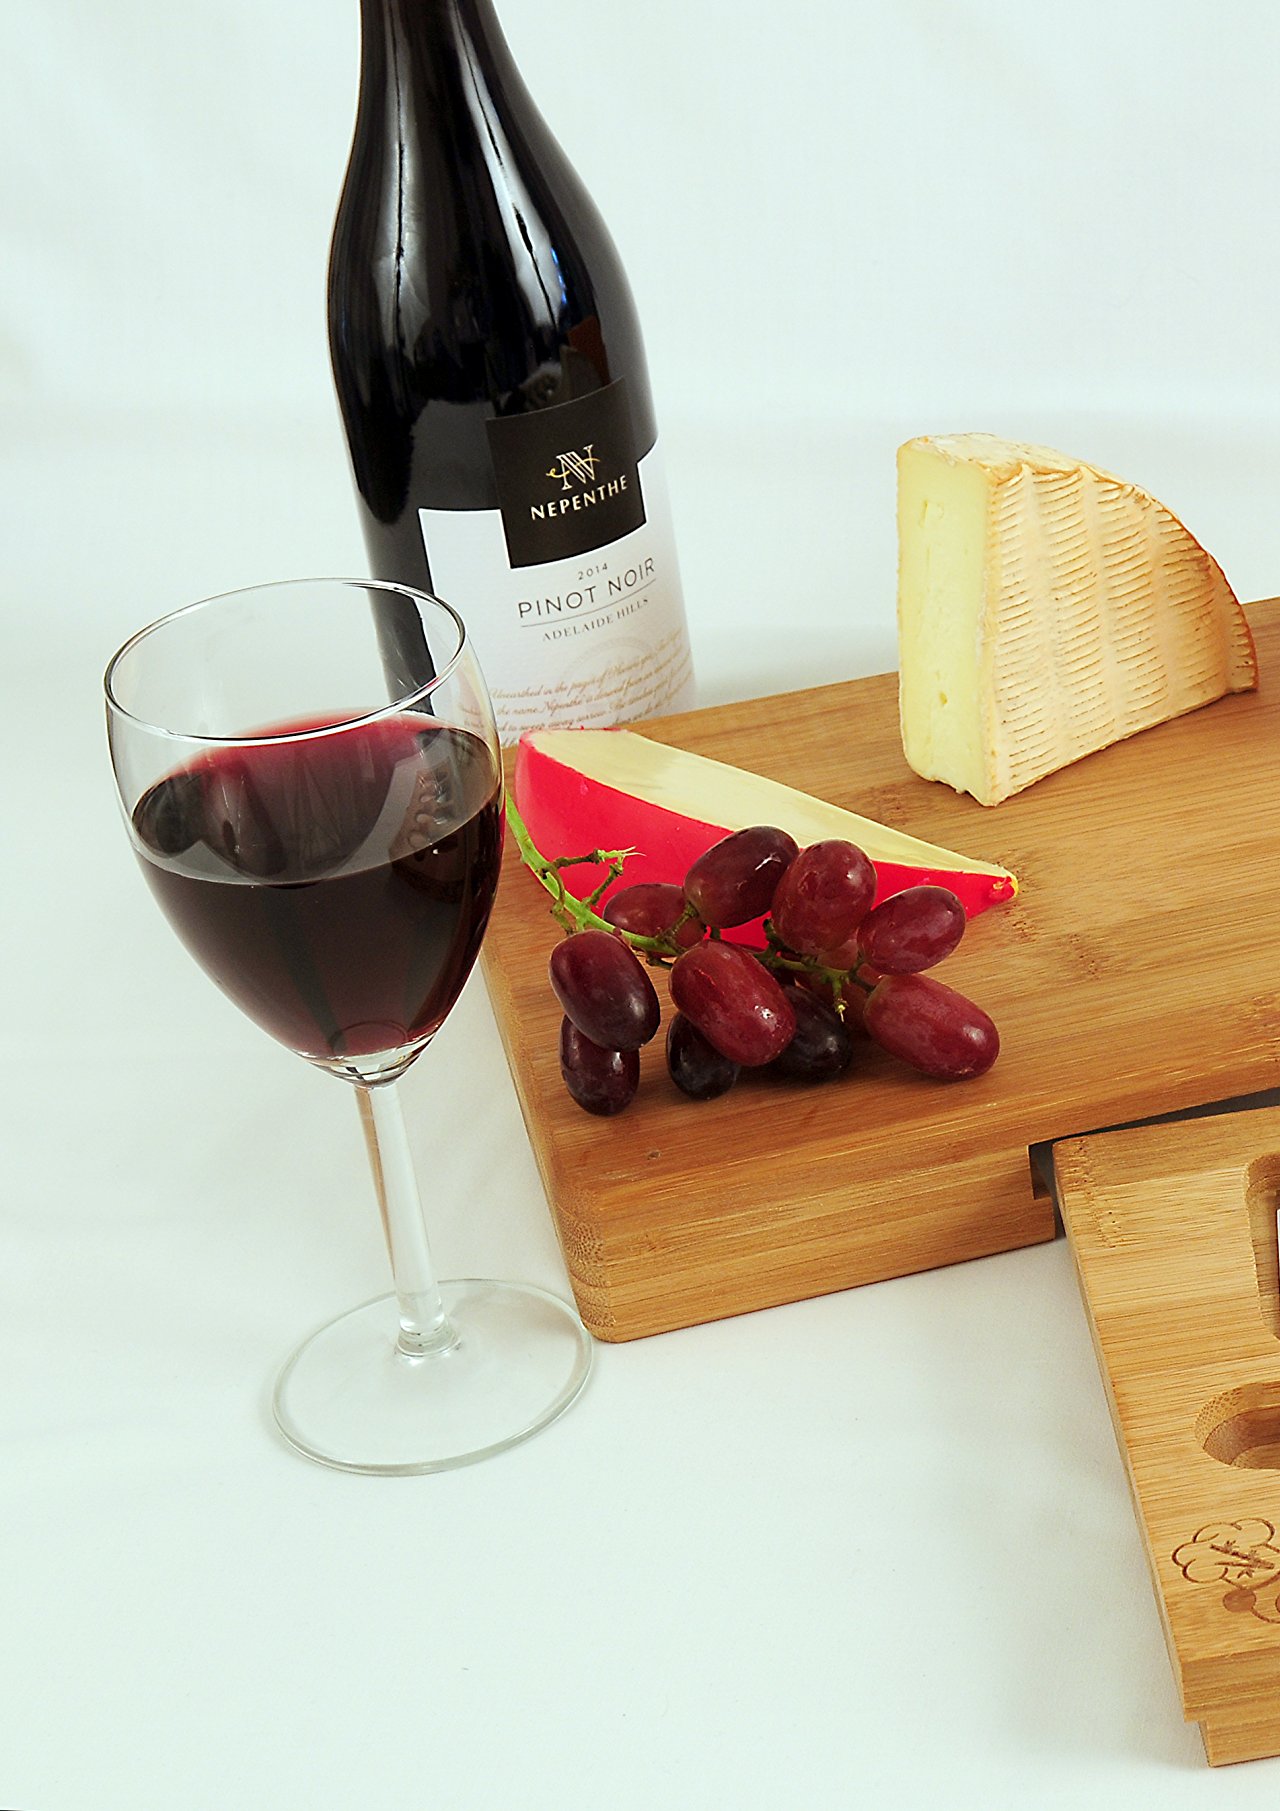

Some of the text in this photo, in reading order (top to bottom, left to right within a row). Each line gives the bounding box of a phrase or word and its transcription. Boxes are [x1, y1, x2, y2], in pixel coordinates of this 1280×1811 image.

[530, 474, 627, 520] NEPENTHE
[518, 557, 655, 618] PINOT NOIR
[577, 562, 609, 580] 2014
[542, 598, 649, 642] ADELAIDE HILLS
